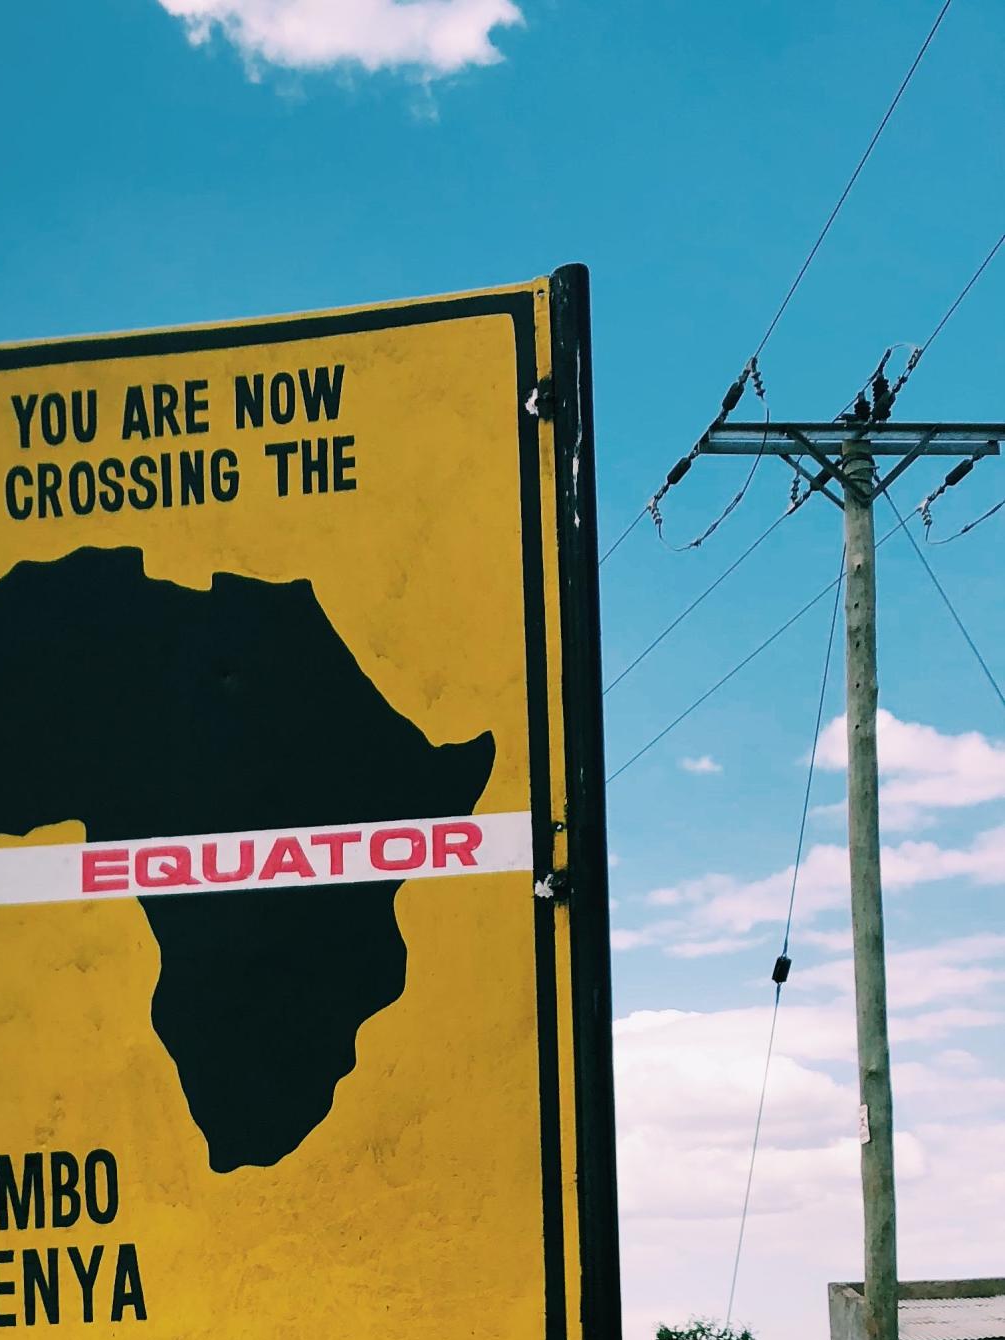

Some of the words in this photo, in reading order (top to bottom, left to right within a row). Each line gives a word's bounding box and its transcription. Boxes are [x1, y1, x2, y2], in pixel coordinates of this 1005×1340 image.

[11, 389, 97, 449] YOU
[122, 380, 209, 440] ARE
[235, 364, 345, 429] NOW
[6, 449, 239, 520] CROSSING
[265, 435, 356, 497] THE
[82, 822, 482, 893] EQUATOR
